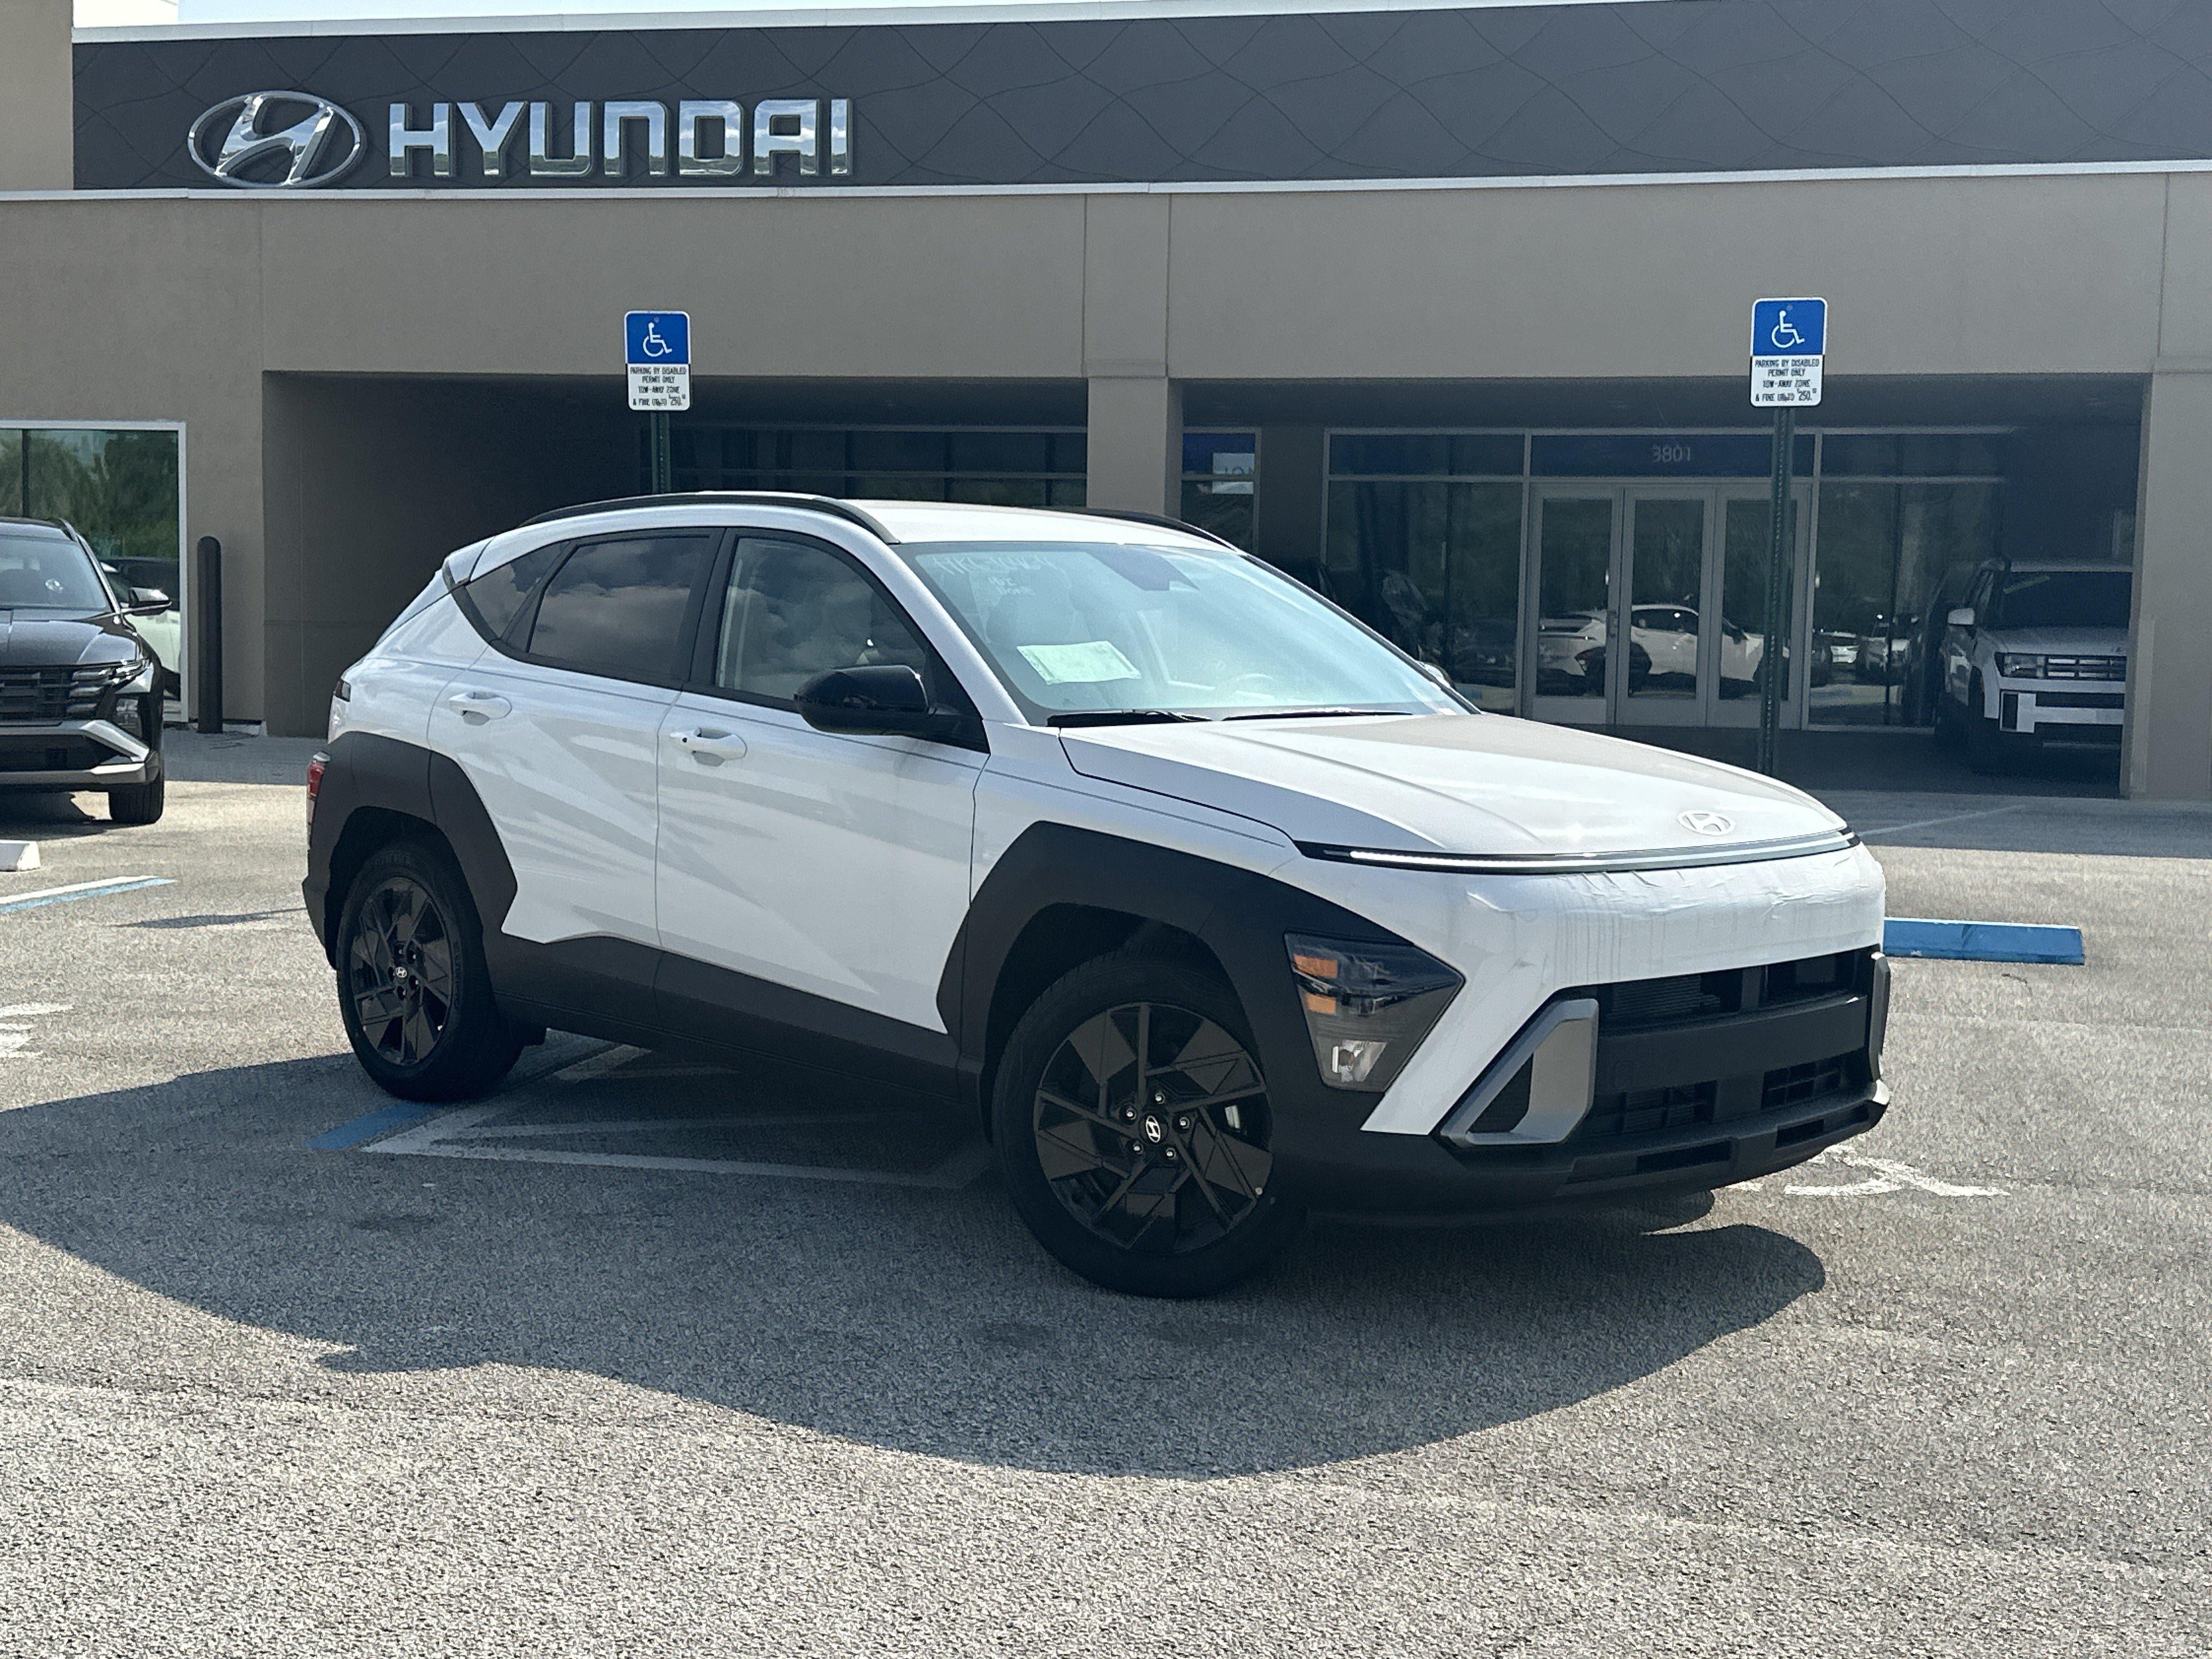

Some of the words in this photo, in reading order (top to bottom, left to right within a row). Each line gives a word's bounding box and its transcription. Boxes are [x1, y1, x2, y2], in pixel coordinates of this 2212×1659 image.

[388, 98, 853, 178] HYUNDAI
[1754, 359, 1779, 368] PARKING
[1791, 358, 1819, 366] DISABLED
[1649, 444, 1690, 462] 3801
